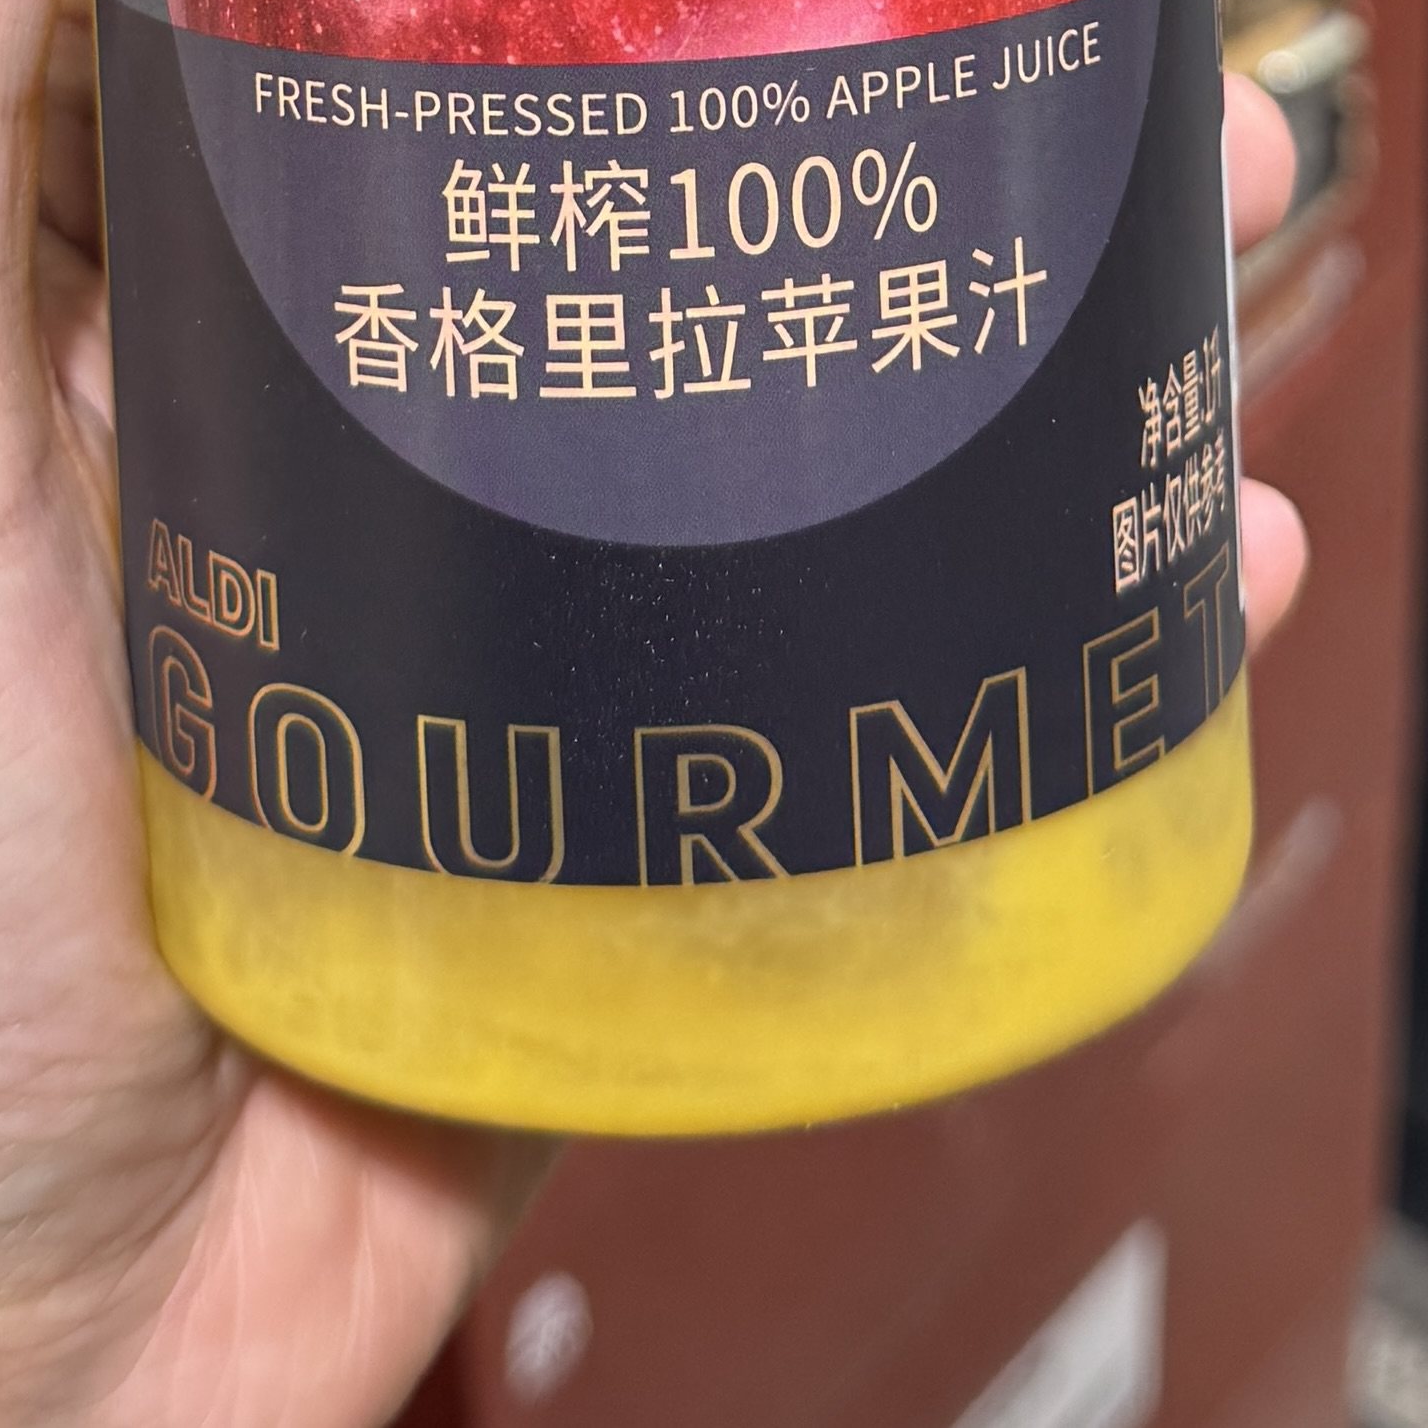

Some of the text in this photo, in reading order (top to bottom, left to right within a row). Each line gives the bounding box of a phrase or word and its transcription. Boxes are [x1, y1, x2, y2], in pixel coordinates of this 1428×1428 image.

[253, 21, 1102, 138] FRESH-PRESSED 100% APPLE JUICE
[442, 140, 939, 273] 鲜榨100%
[331, 235, 1049, 401] 香格里拉苹果汁
[145, 518, 280, 650] ALDI
[148, 541, 1230, 887] GOURMET
